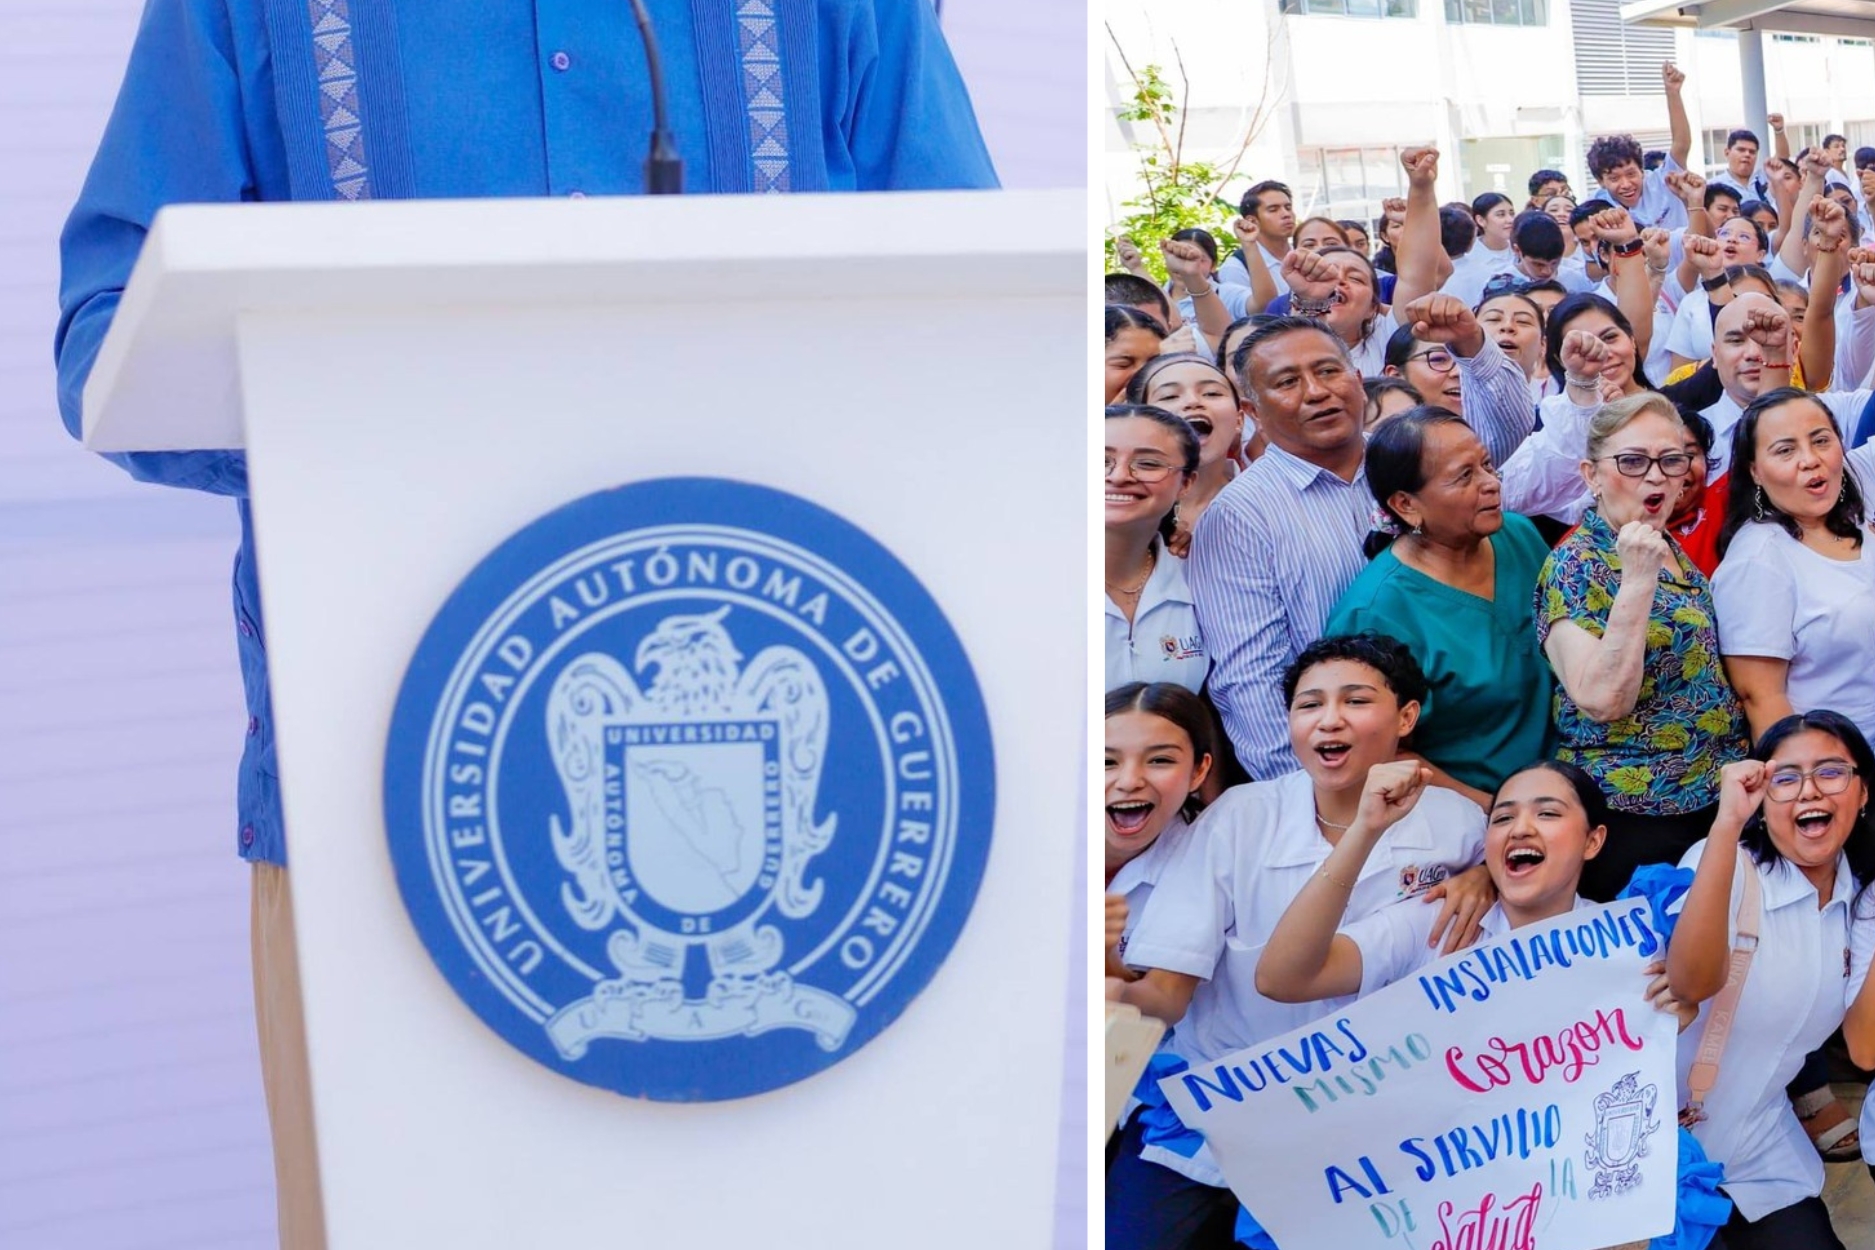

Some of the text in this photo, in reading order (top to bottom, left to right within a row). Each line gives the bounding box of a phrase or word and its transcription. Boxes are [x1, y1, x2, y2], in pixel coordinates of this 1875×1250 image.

[450, 544, 933, 977] UNIVERSIDAD AUTÓNOMA DE GUERRERO
[606, 722, 775, 746] UNIVERSIDAD
[681, 916, 712, 933] DE
[1182, 905, 1659, 1113] NUEVAS INSTALACIONES
[1292, 1032, 1432, 1113] MISMO
